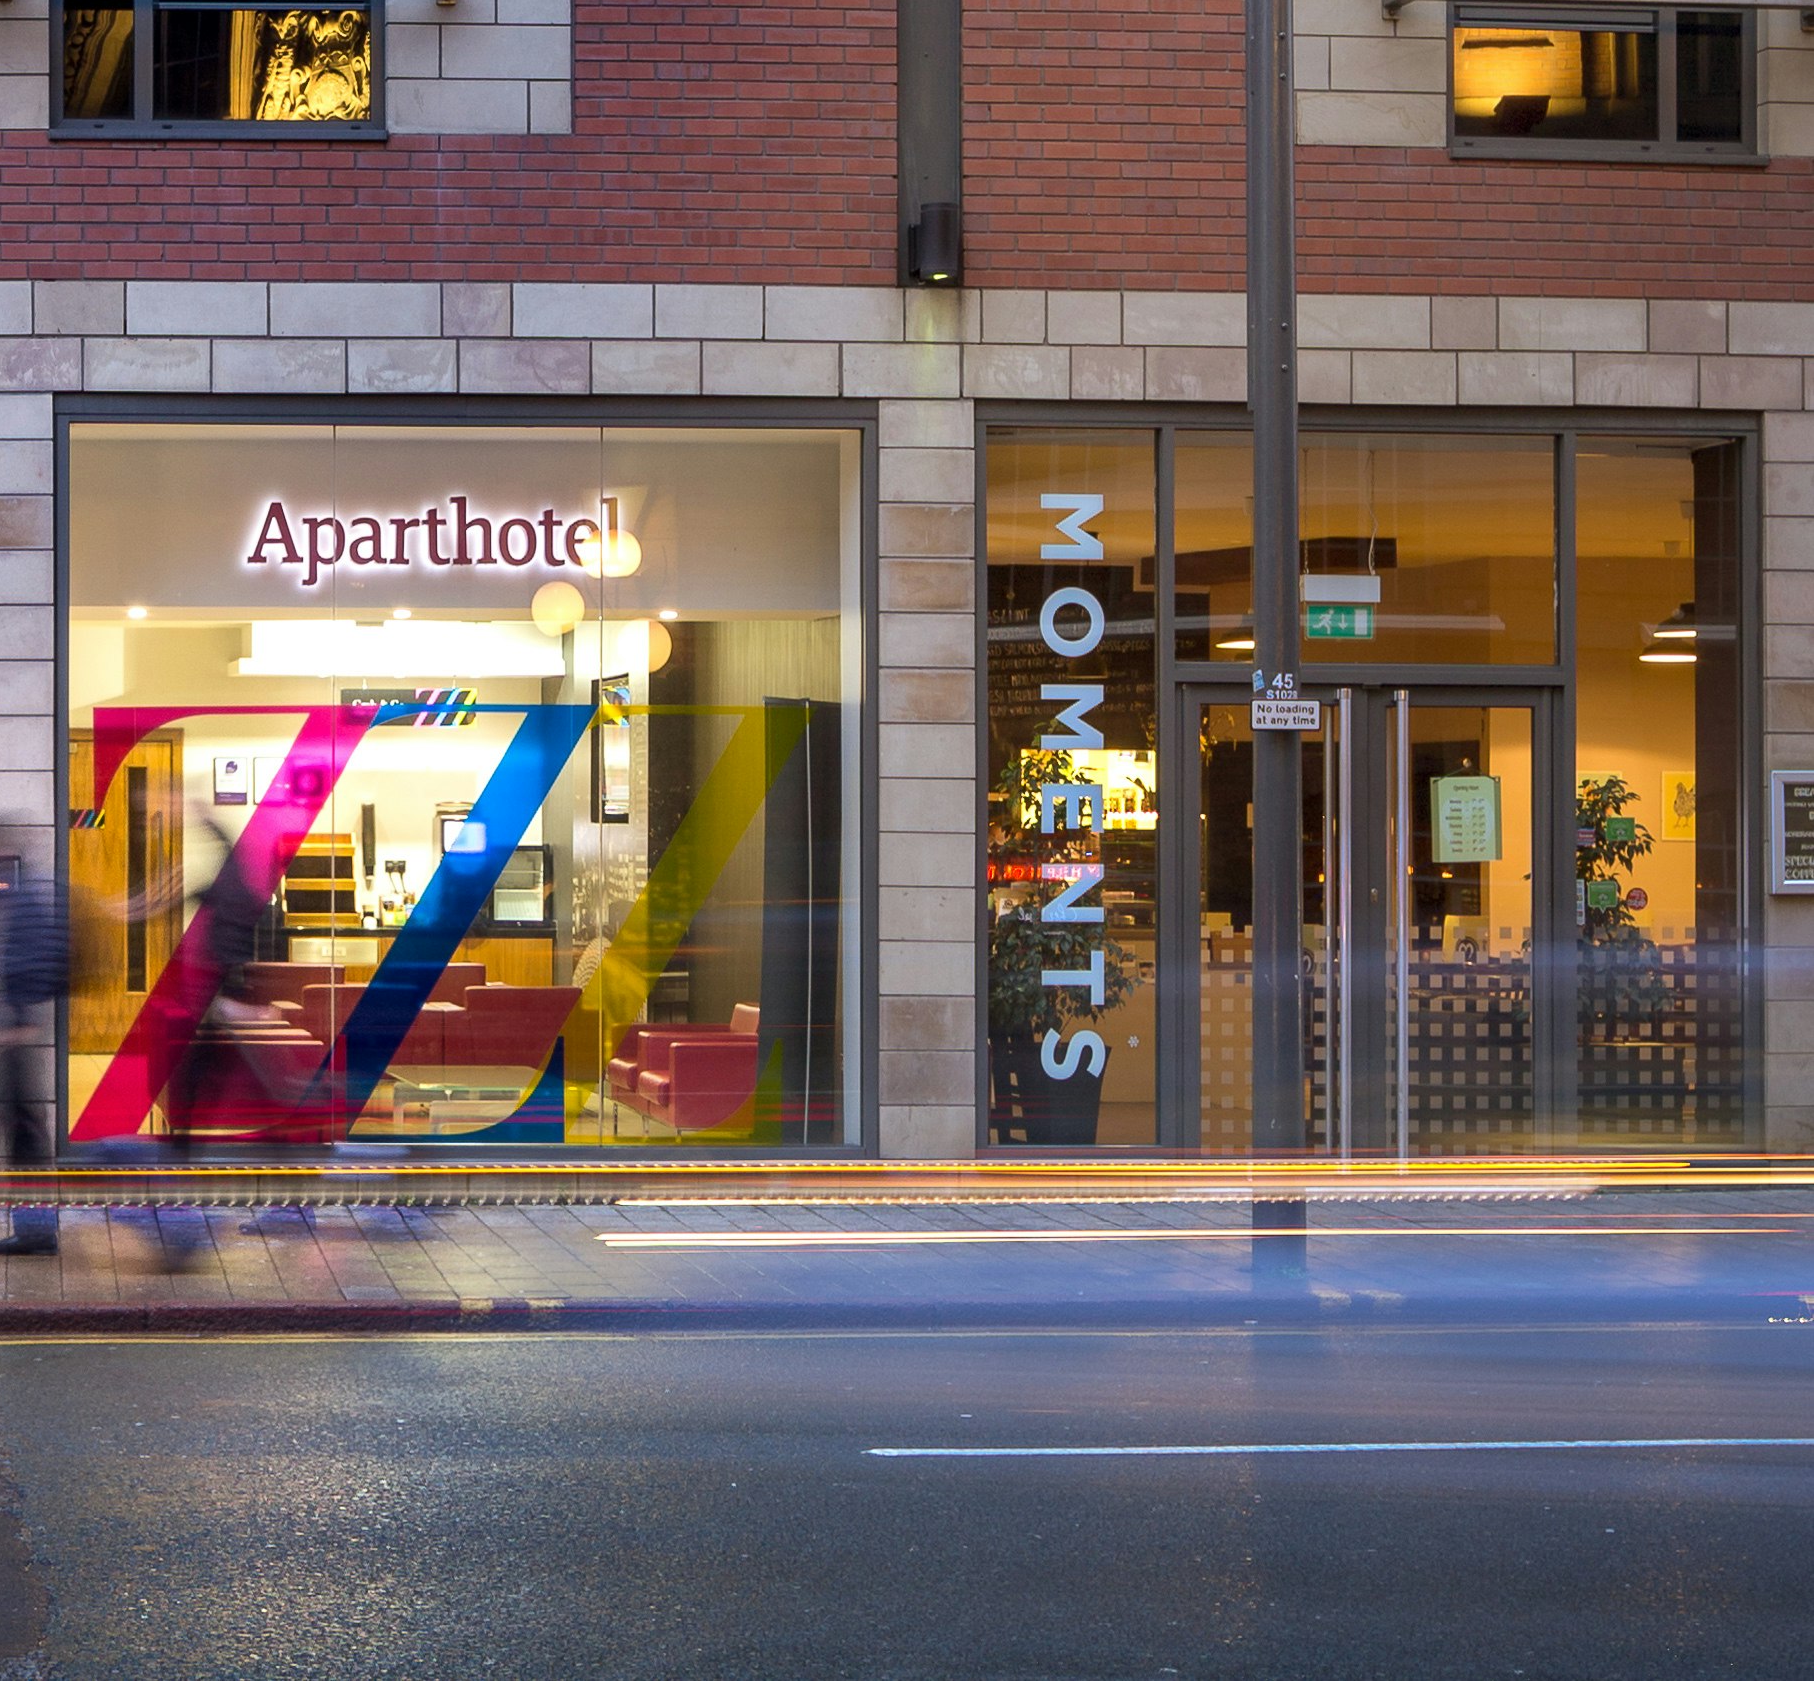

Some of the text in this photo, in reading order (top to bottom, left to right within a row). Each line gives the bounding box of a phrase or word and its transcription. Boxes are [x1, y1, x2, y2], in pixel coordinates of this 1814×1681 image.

[246, 495, 619, 586] Aparthotel
[1271, 673, 1294, 689] 45
[1257, 704, 1315, 715] No loading
[1256, 716, 1316, 726] at any time
[1040, 492, 1107, 1080] MOMENTS
